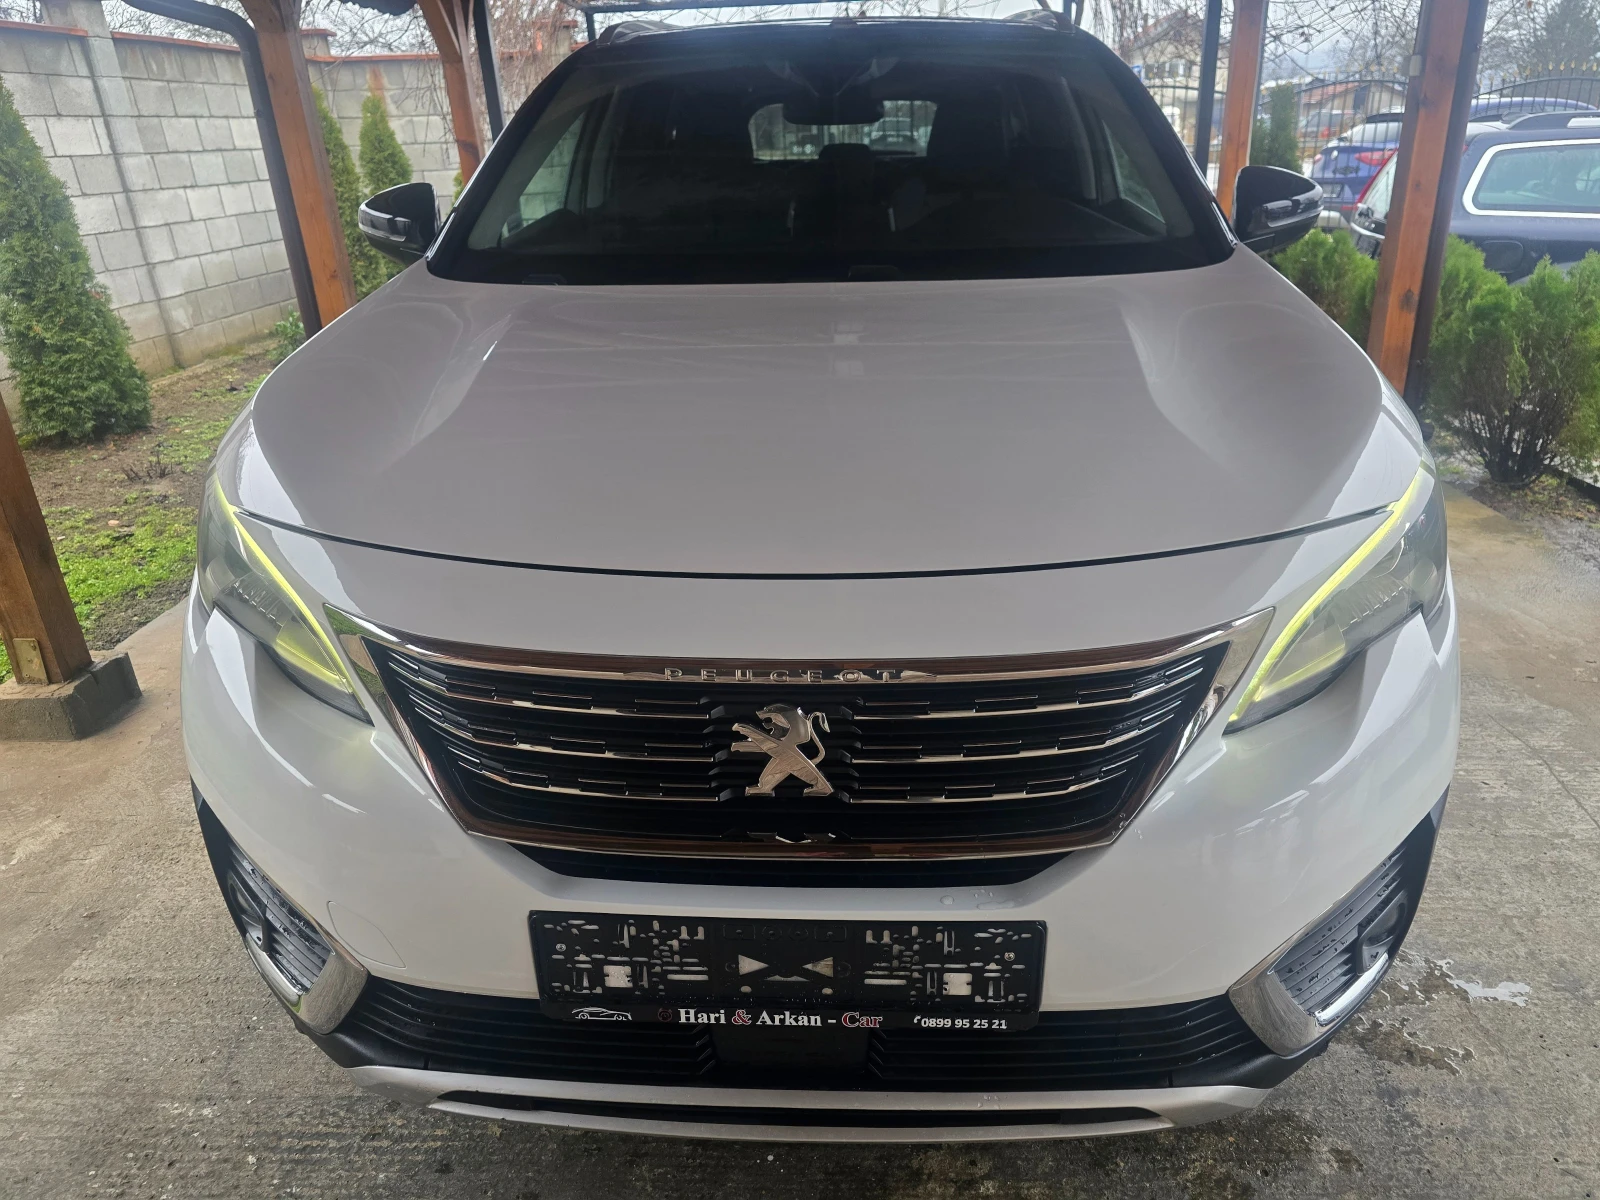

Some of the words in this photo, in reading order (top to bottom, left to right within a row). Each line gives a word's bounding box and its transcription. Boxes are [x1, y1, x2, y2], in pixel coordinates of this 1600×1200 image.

[664, 667, 896, 683] PEUGEOT
[678, 1008, 726, 1024] Hari
[731, 1009, 752, 1025] &
[755, 1010, 822, 1027] Arkan
[841, 1011, 883, 1028] Car
[921, 1018, 952, 1028] 0899
[954, 1019, 970, 1028] 95
[973, 1019, 989, 1029] 25
[991, 1019, 1008, 1029] 21
